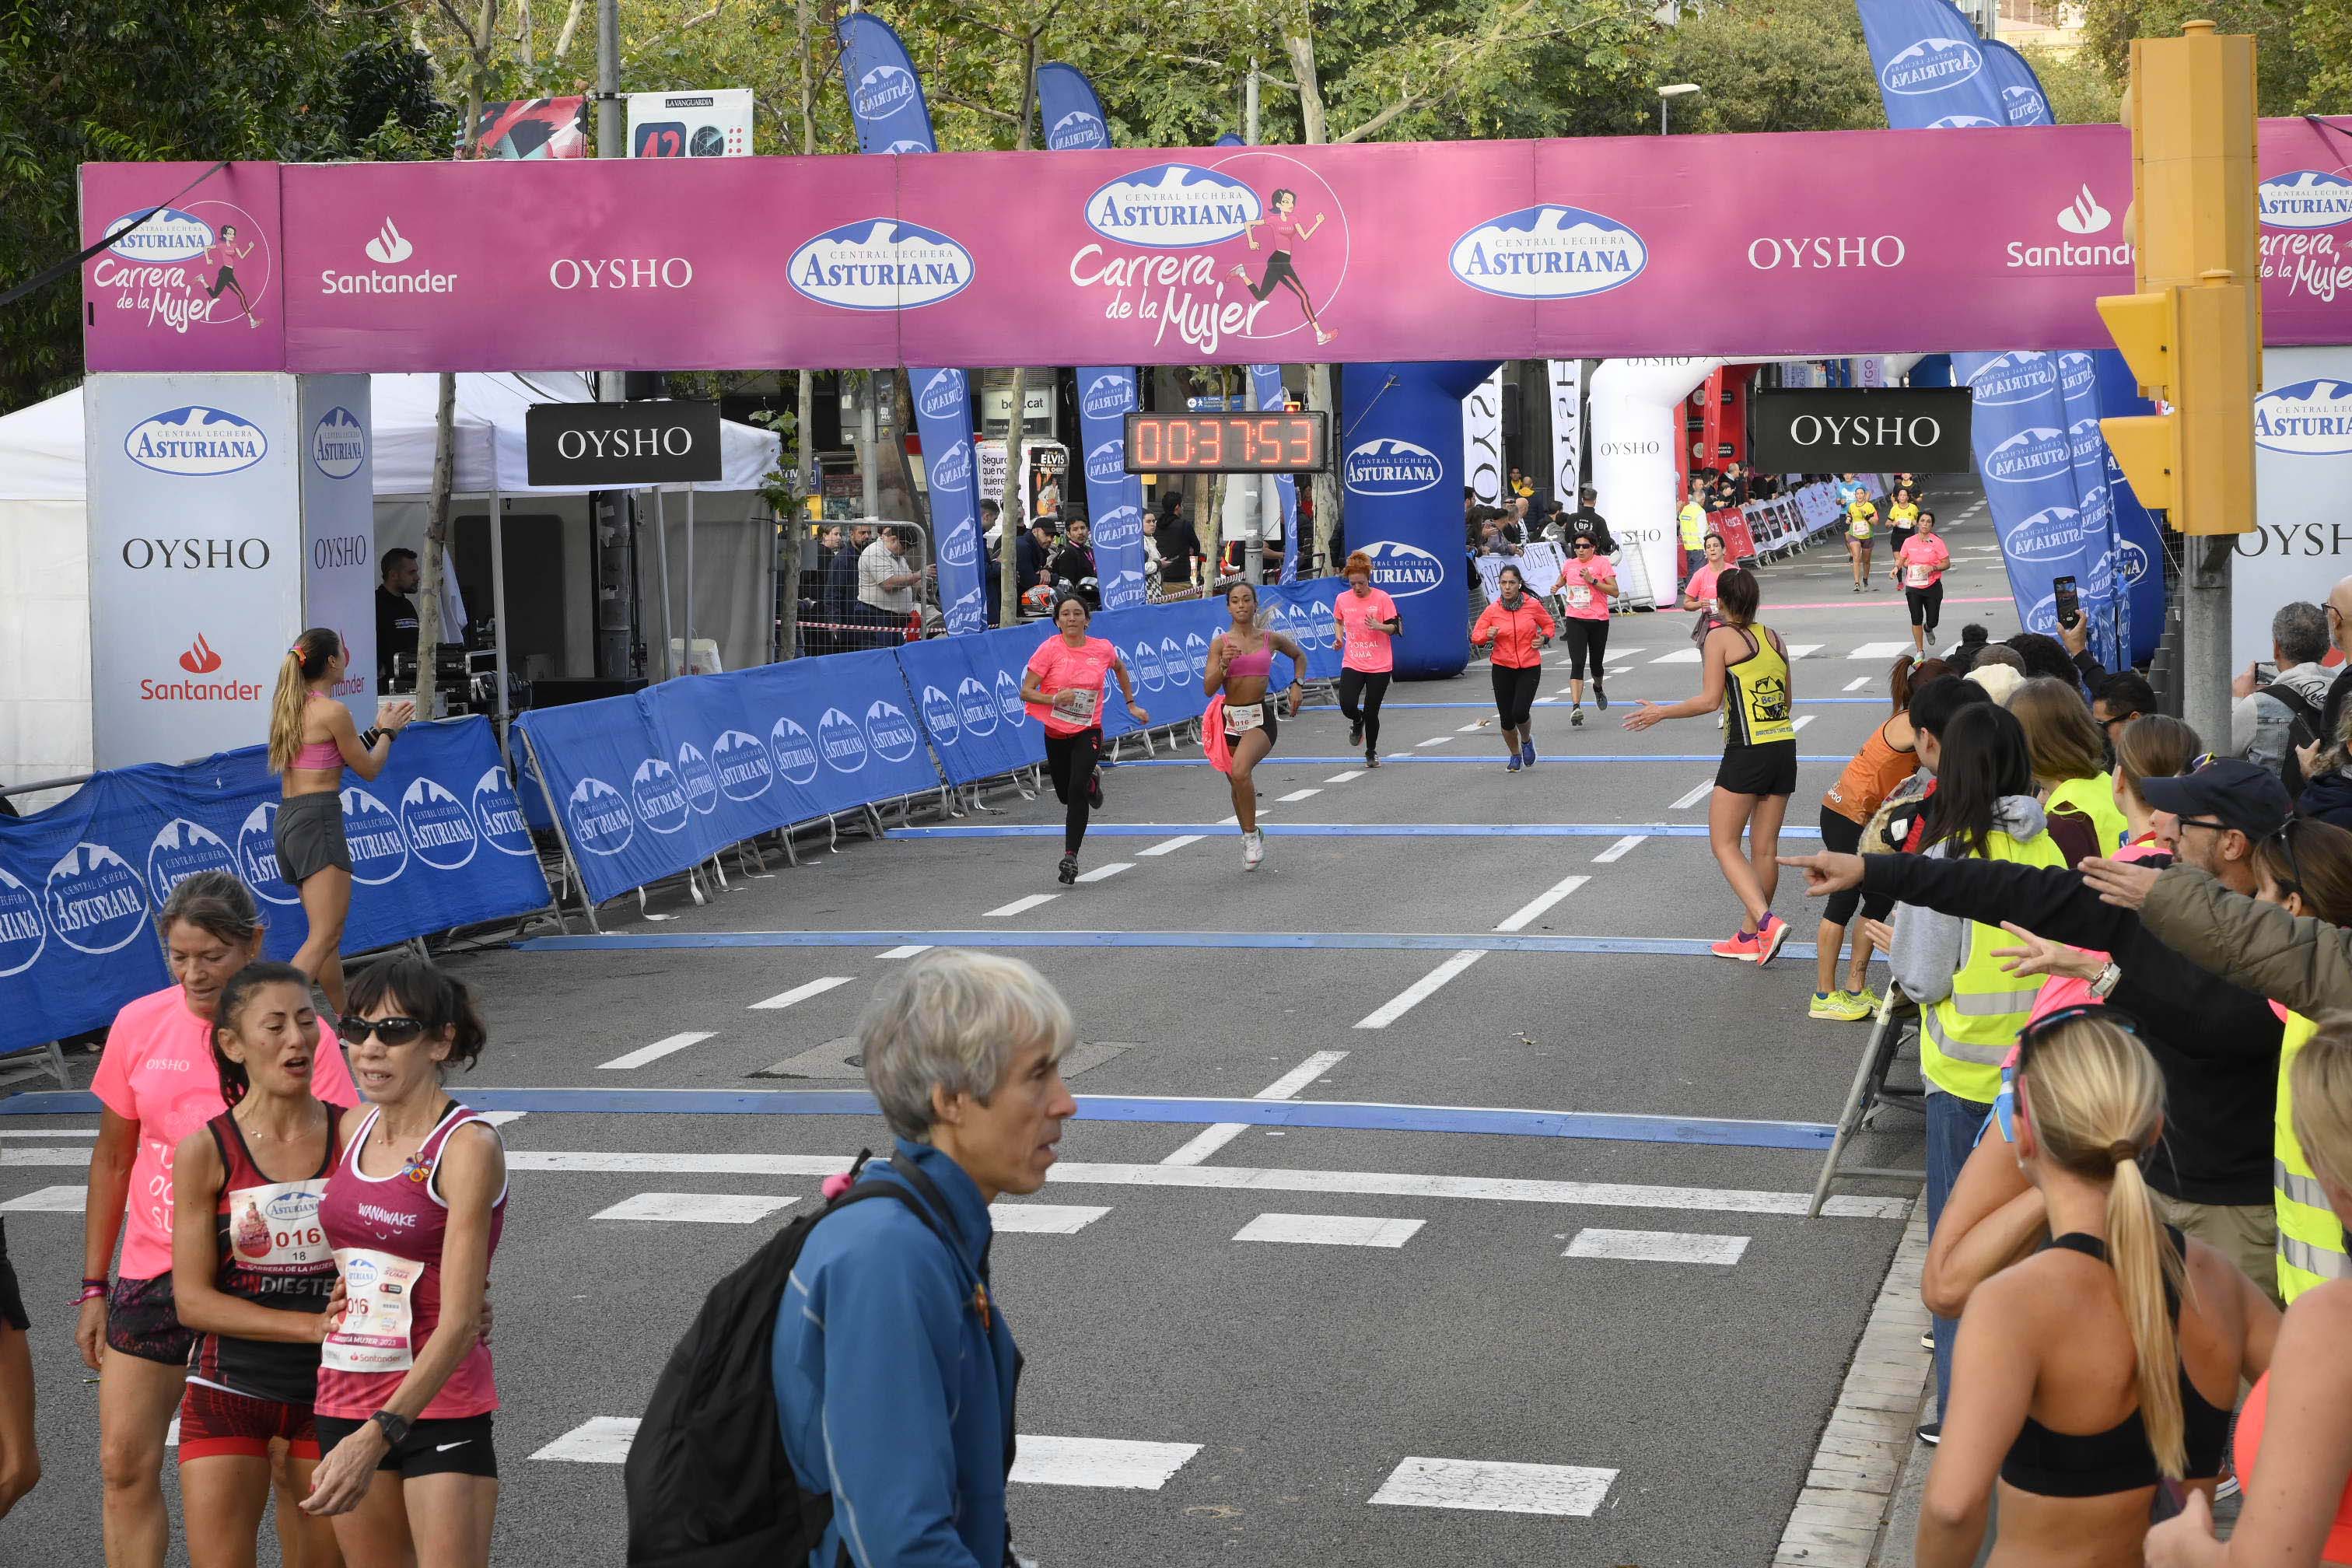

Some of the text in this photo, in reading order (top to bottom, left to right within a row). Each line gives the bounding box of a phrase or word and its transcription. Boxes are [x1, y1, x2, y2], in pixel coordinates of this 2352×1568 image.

[1125, 191, 1243, 202] CENTRAL LECHERA
[1098, 194, 1247, 227] ASTURIANA
[830, 249, 954, 260] CENTRAL LECHERA
[1495, 236, 1626, 248] CENTRAL LECHERA
[1748, 236, 1906, 270] OYSHO
[2259, 233, 2334, 256] arrera
[800, 253, 961, 287] ASTURIANA
[1070, 243, 1214, 287] Carrera
[1464, 241, 1633, 276] ASTURIANA
[94, 258, 186, 289] Carrera
[322, 268, 458, 294] Santander
[549, 257, 693, 289] OYSHO
[2278, 255, 2293, 278] la
[2289, 252, 2352, 303] Muje
[117, 285, 221, 334] de la Mujer
[1105, 281, 1270, 355] de la Mujer
[2276, 405, 2329, 415] CENTRAL
[557, 427, 692, 459] OYSHO
[1137, 420, 1311, 464] 00:37:53
[1790, 415, 1941, 447] OYSHO
[136, 432, 257, 460] ASTURIANA
[317, 434, 362, 461] ASTURIANA
[1041, 453, 1065, 464] ELVIS
[1601, 441, 1660, 457] OYSHO
[1348, 461, 1436, 483] ASTURIANA
[1624, 528, 1661, 543] SHO
[2233, 523, 2352, 557] OYSH
[122, 538, 270, 569] OYSHO
[314, 535, 366, 569] OYSHO
[141, 678, 263, 701] Santander
[330, 673, 366, 699] ntander
[368, 816, 393, 829] LECHERA
[414, 805, 460, 821] CENTRAL LECHERA
[482, 803, 527, 837] ASTUR
[408, 814, 473, 850] ASTURIANA
[146, 1058, 190, 1072] OYSHO
[359, 1202, 417, 1227] WANAWAKE
[275, 1227, 321, 1248] 016
[292, 1251, 306, 1262] 18
[310, 1262, 334, 1272] MUJER
[354, 1336, 377, 1345] MUJER
[359, 1353, 401, 1363] Santander
